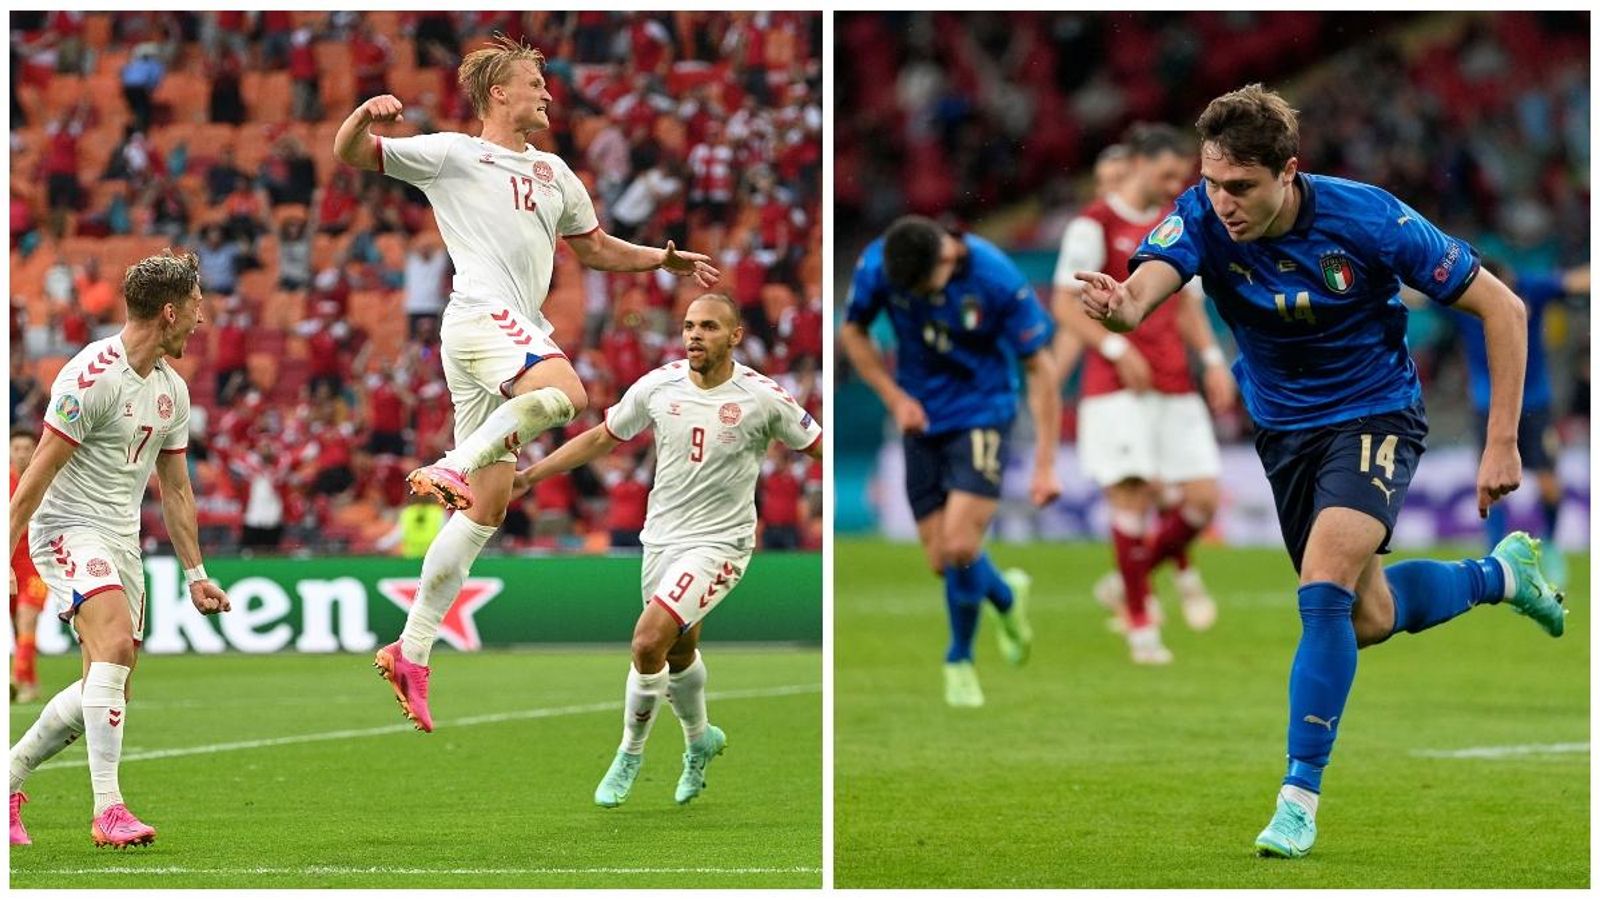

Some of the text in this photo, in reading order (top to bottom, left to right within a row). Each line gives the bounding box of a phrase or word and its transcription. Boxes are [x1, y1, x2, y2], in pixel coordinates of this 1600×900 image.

[510, 176, 537, 212] 12
[1275, 291, 1316, 325] 14
[690, 426, 705, 463] 9
[1360, 434, 1399, 480] 14
[36, 557, 377, 654] ken
[668, 572, 695, 603] 9
